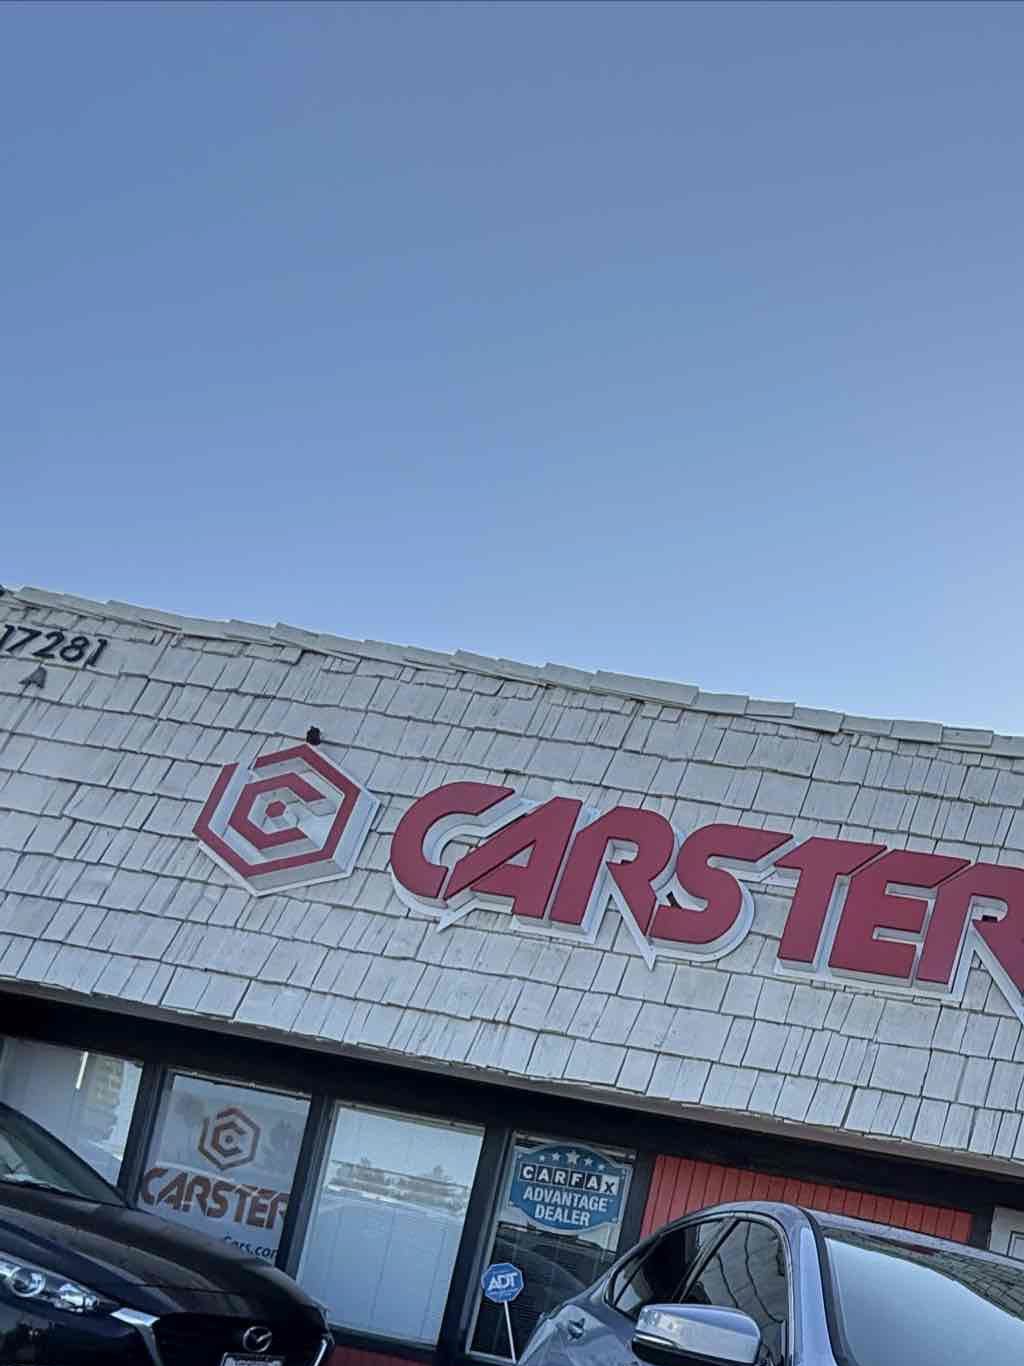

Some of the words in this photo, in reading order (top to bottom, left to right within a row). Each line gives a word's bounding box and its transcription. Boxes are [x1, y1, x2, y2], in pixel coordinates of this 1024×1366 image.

[0, 624, 108, 667] 17281
[18, 665, 48, 689] A
[521, 1165, 618, 1196] CARFAX
[522, 1186, 609, 1212] ADVANTAGE
[534, 1204, 591, 1226] DEALER
[487, 1272, 518, 1290] ADT
